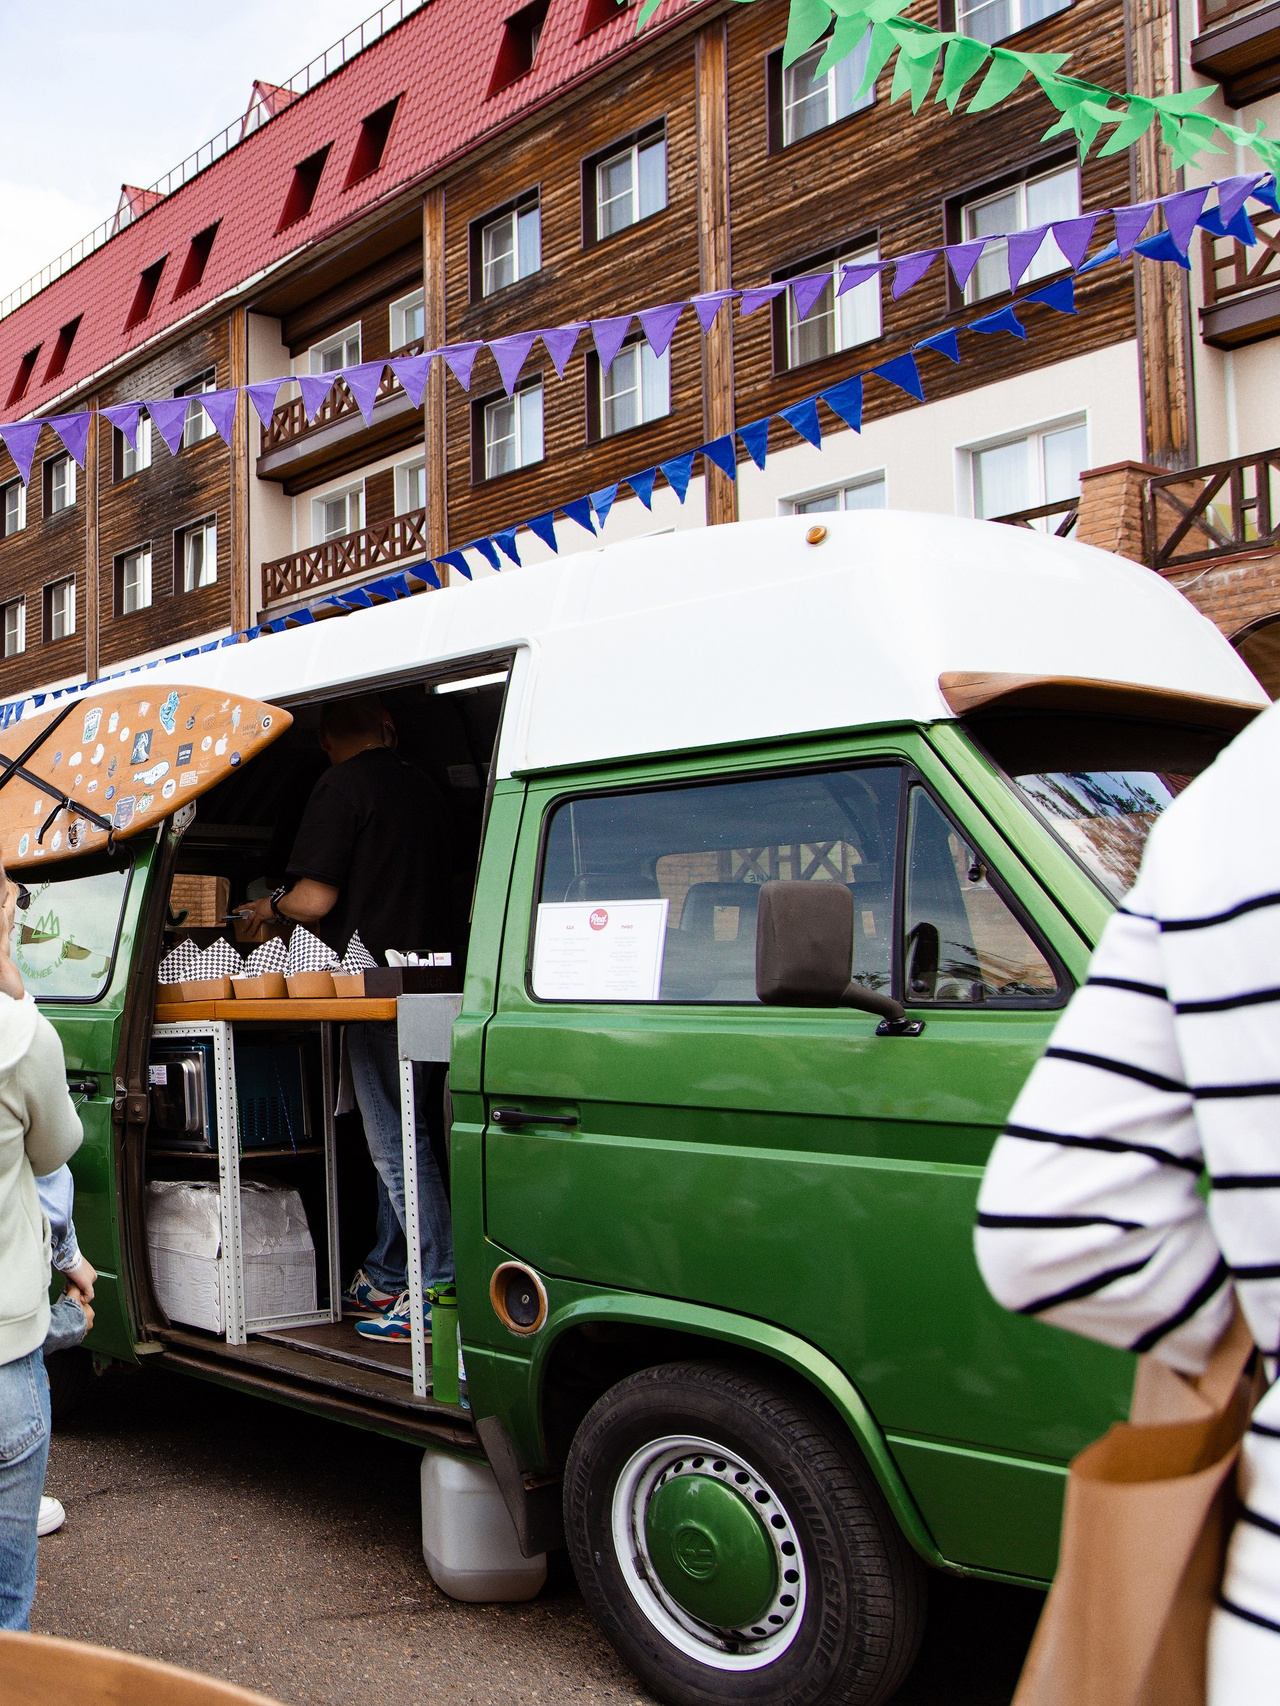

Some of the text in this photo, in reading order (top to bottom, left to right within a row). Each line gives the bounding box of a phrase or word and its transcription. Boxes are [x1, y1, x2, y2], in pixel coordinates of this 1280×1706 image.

[263, 717, 270, 728] G
[137, 796, 153, 809] PLUS
[591, 913, 607, 924] Red
[21, 963, 53, 979] ВАЖНЕЕ
[776, 1462, 845, 1666] BRIDGESTONE
